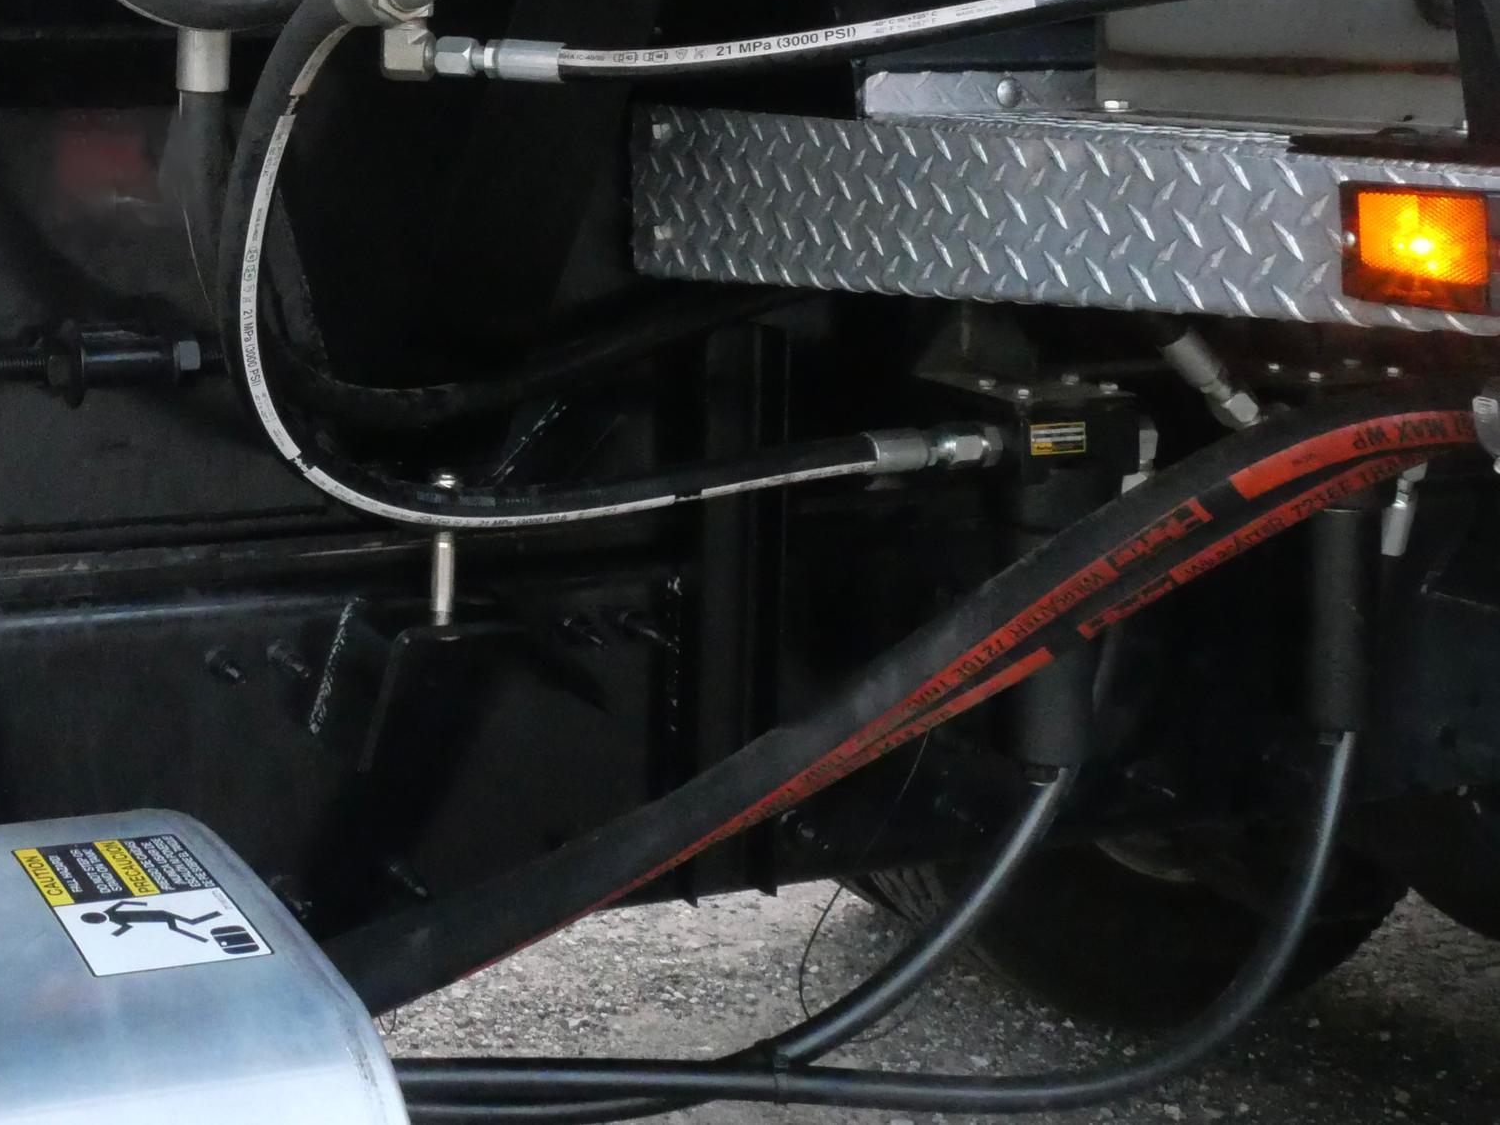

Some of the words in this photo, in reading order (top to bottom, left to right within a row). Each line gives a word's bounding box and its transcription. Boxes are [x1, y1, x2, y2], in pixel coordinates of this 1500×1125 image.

[716, 46, 732, 57] 21
[739, 41, 772, 54] MPa
[776, 33, 818, 50] (3000
[824, 26, 857, 41] PSI)
[243, 308, 253, 324] 21
[243, 324, 254, 343] MPa
[75, 857, 95, 871] STEP
[93, 863, 109, 872] ON
[22, 855, 65, 896] CAUTION
[86, 872, 104, 883] NOT
[99, 872, 123, 891] STAND
[63, 878, 84, 892] FALL
[95, 883, 112, 893] DO
